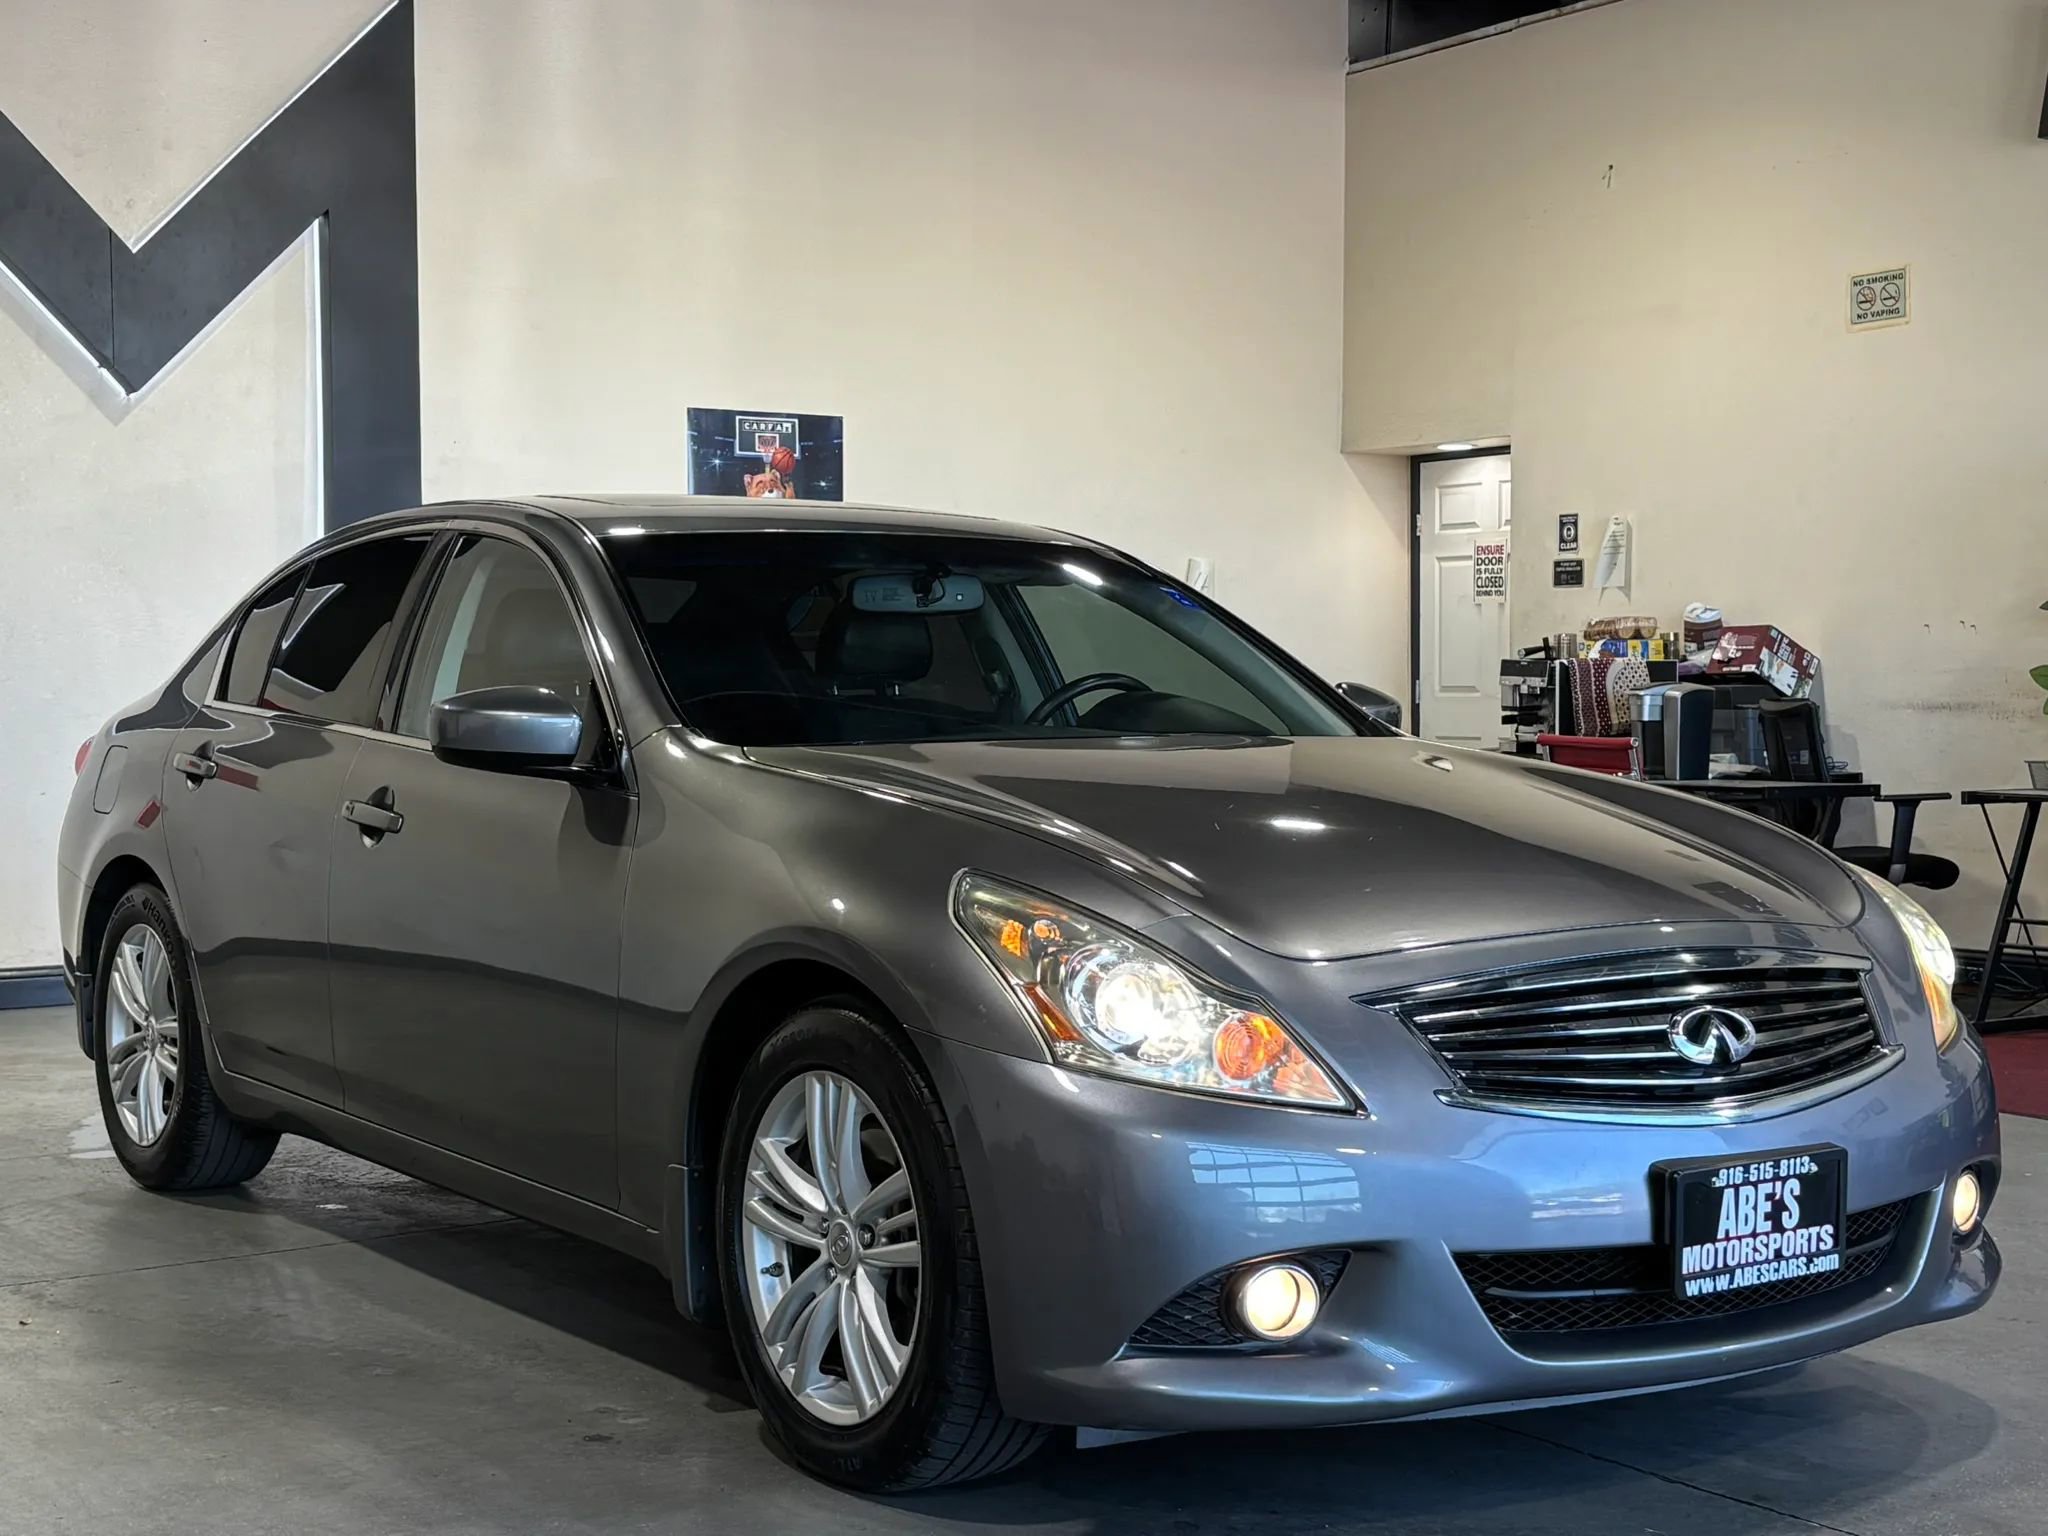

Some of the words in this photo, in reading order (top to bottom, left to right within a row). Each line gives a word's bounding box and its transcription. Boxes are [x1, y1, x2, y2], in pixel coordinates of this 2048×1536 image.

[1866, 272, 1904, 285] SMOKING
[1857, 312, 1868, 320] NO
[1870, 307, 1900, 318] VAPING
[1476, 544, 1504, 556] ENSURE
[1476, 556, 1503, 566] DOOR
[1483, 567, 1503, 575] FULLY
[1476, 575, 1504, 588] CLOSED
[1718, 1155, 1810, 1187] 916-515-8113
[1717, 1178, 1800, 1239] ABE'S
[1682, 1224, 1834, 1275] MOTORSPORTS
